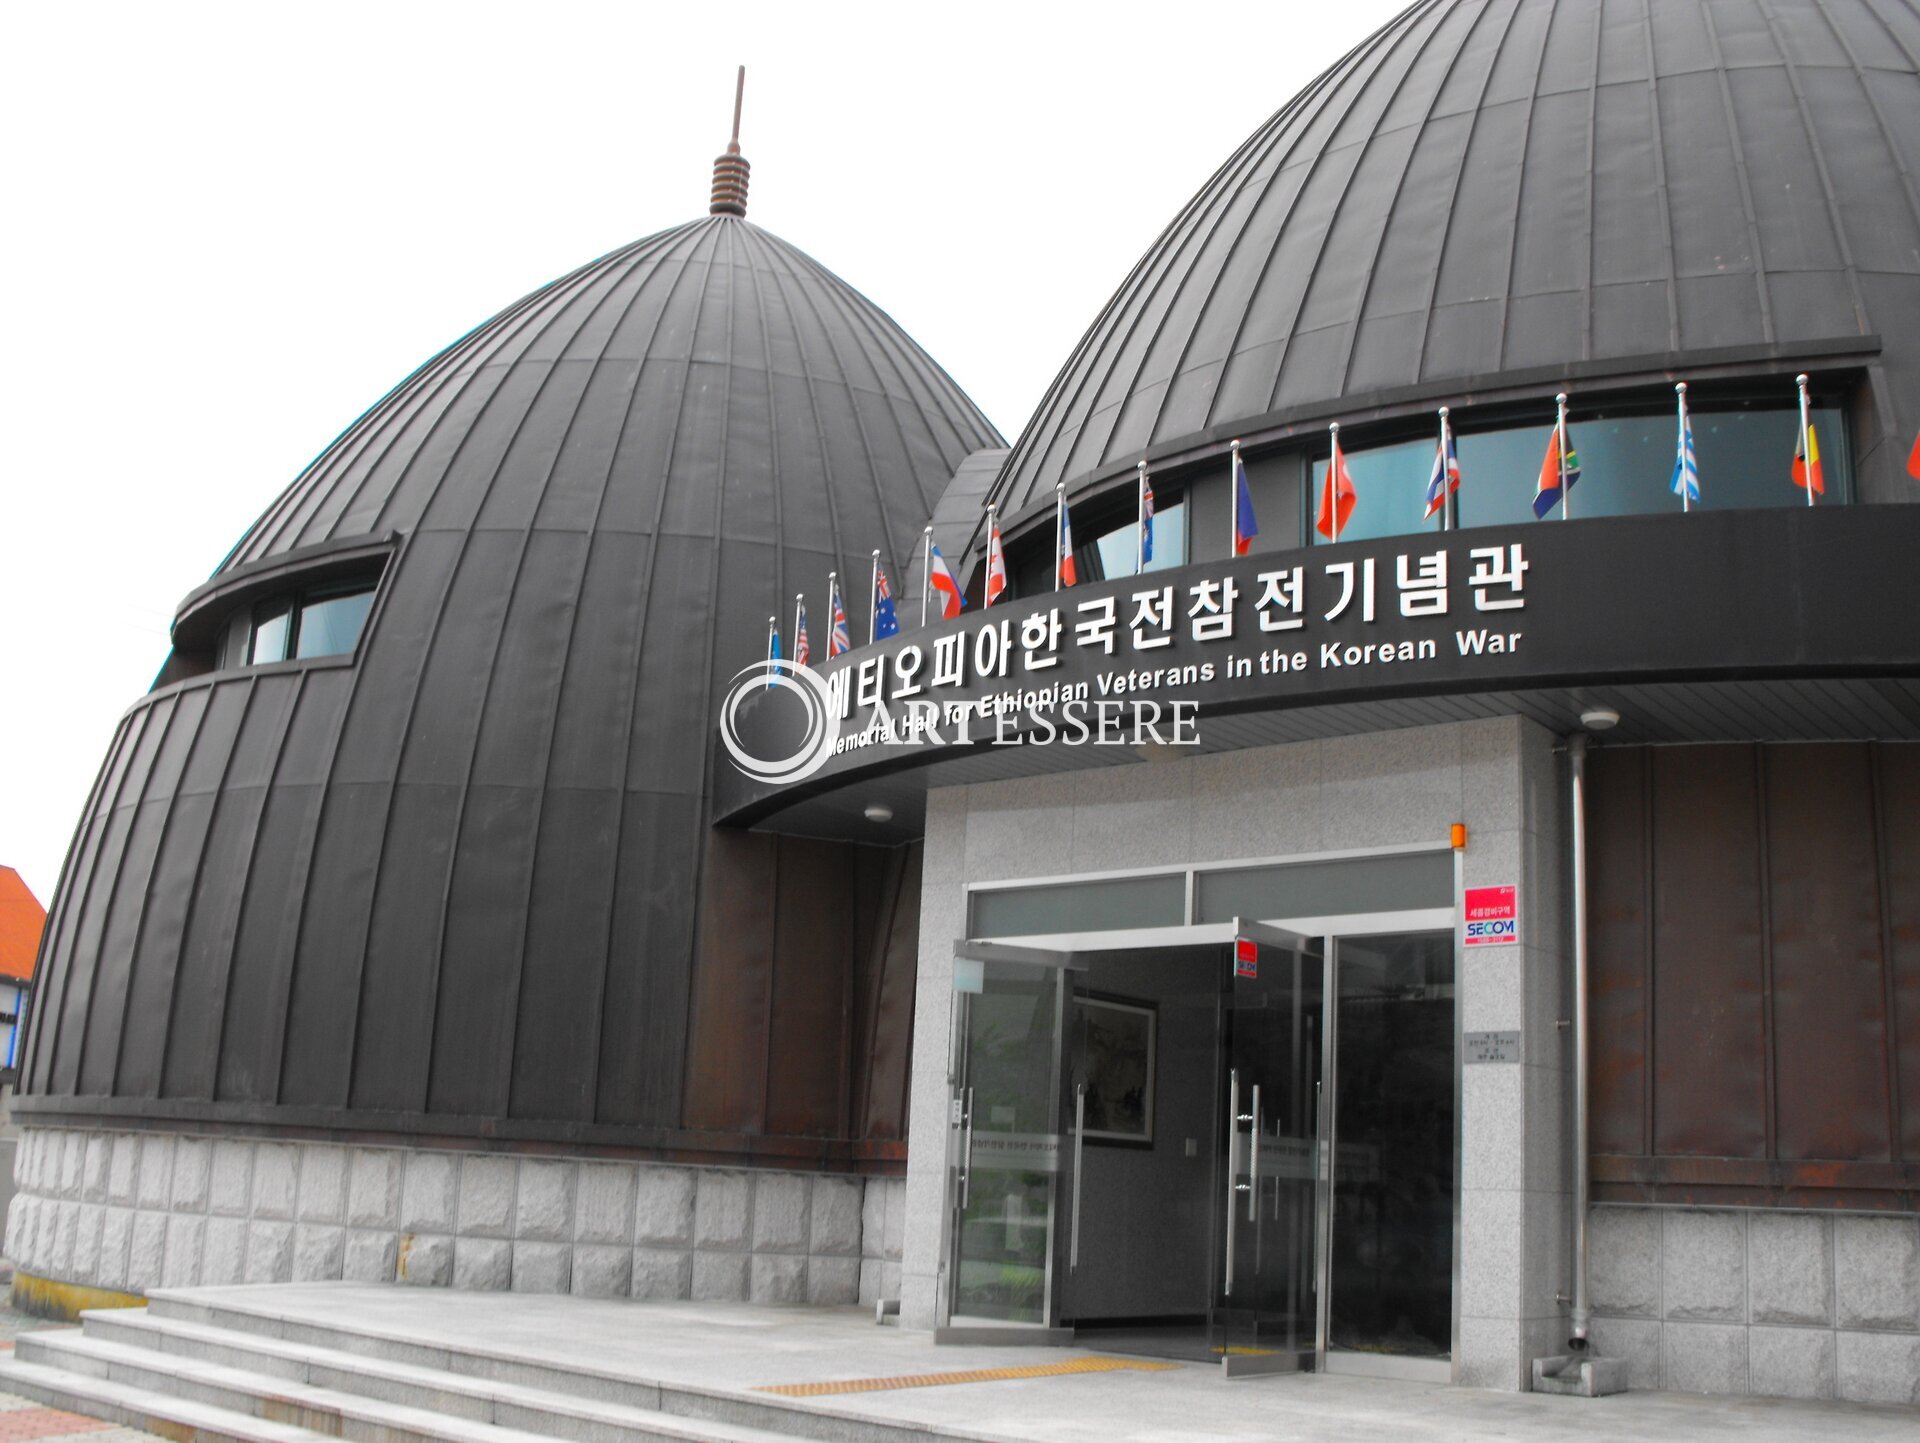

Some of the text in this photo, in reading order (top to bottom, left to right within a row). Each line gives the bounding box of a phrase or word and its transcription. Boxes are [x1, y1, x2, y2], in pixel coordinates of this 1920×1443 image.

[825, 629, 1522, 758] Memorial Hall for Ethiopian Veterans in the Korean War
[1467, 920, 1514, 936] SECOM
